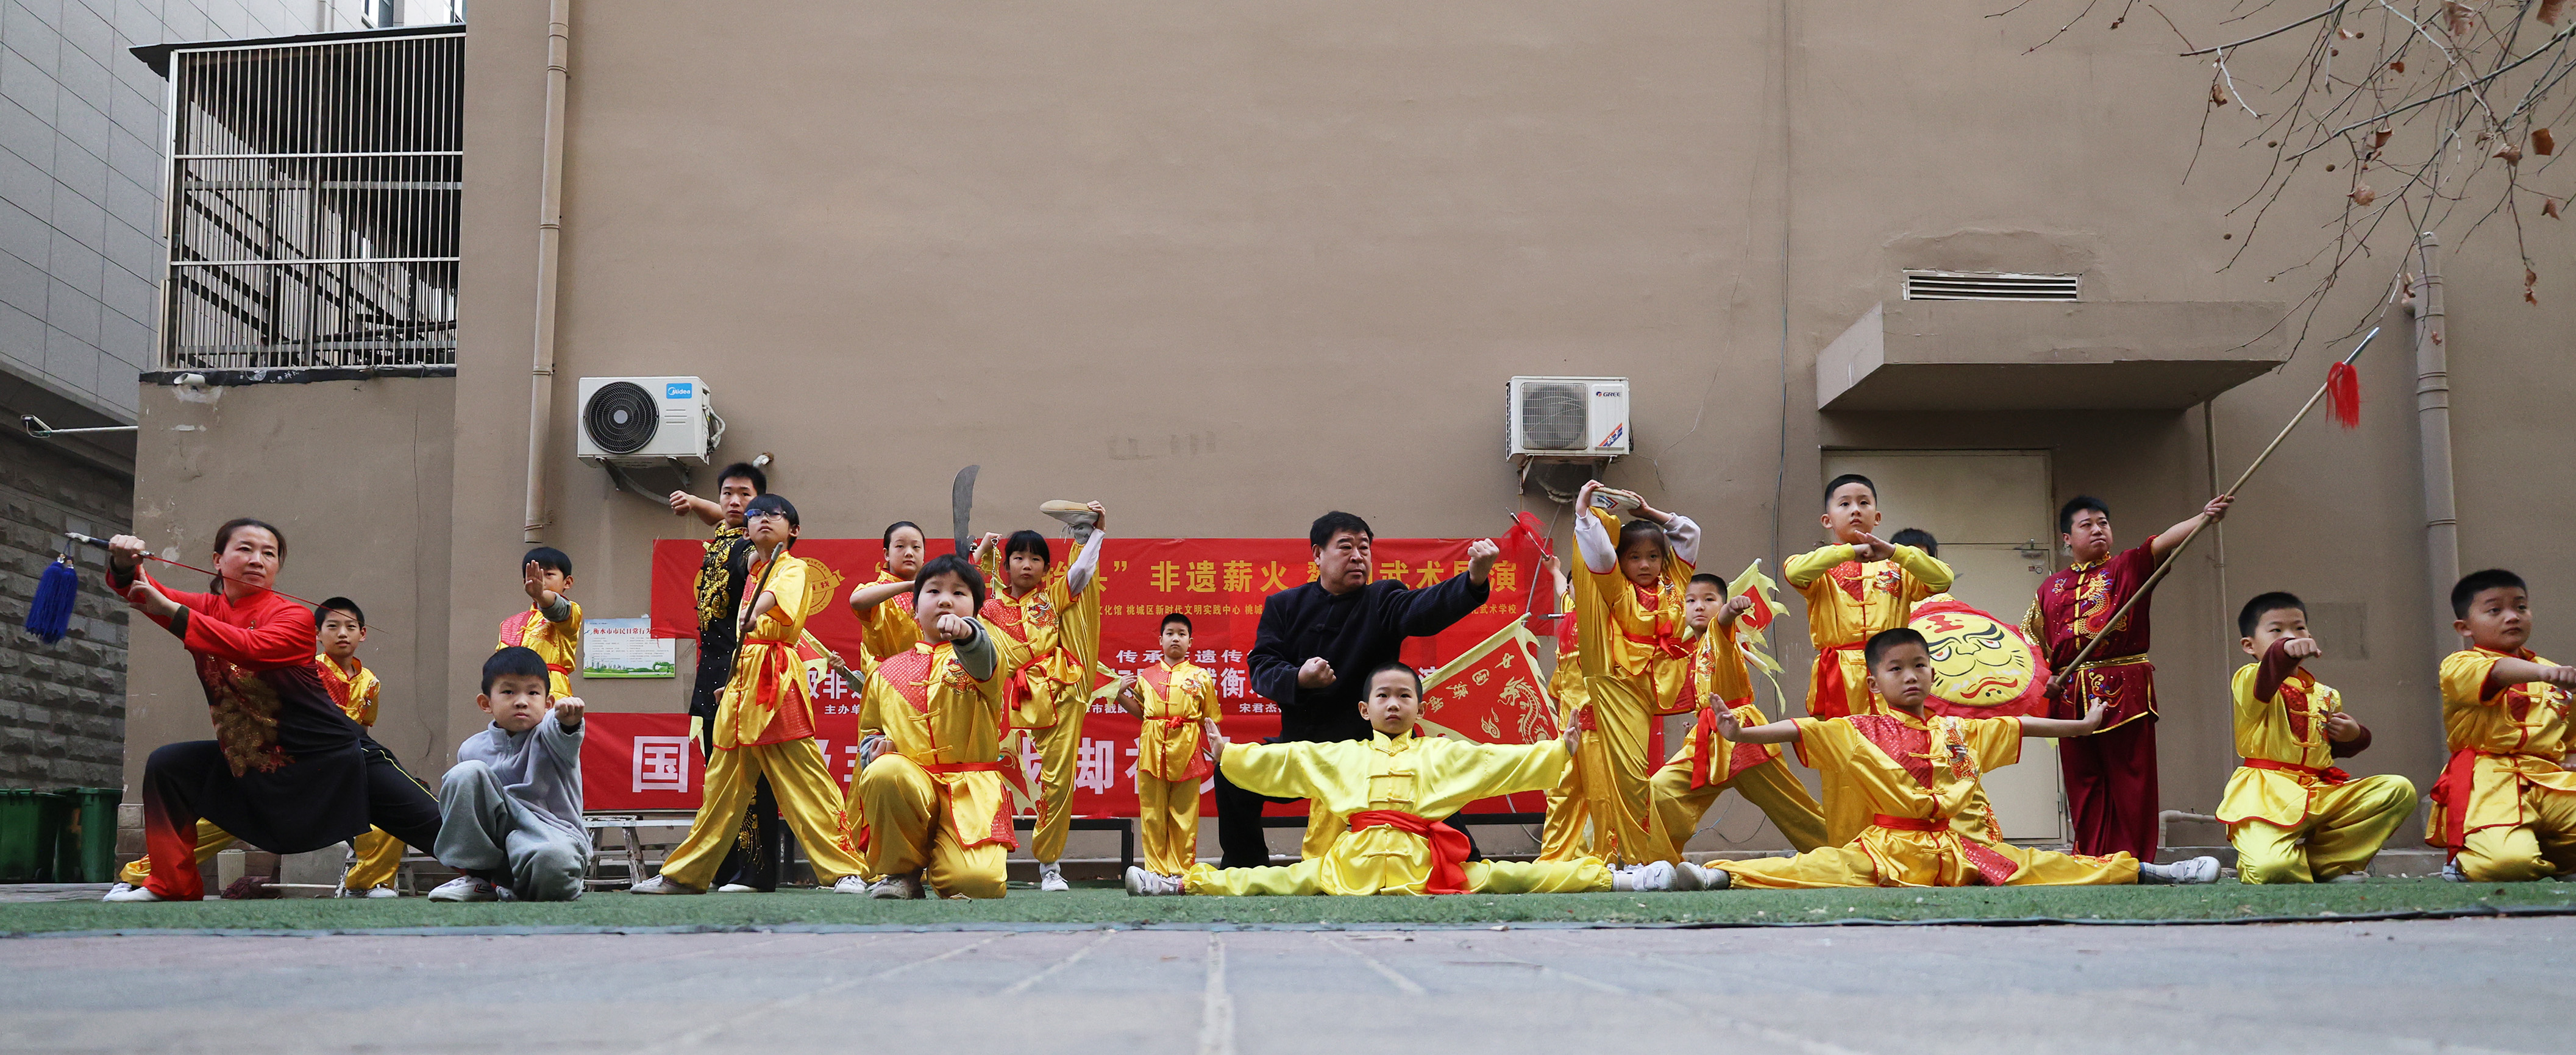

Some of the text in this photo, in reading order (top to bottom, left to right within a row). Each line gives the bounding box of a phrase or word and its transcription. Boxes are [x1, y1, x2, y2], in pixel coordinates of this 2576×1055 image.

[668, 387, 691, 396] Midea
[1150, 560, 1289, 593] 非遗薪火
[1307, 560, 1517, 592] 武术演
[1126, 604, 1240, 616] 桃城区新时代文明实践中心
[1116, 649, 1253, 664] 传承遗传
[1239, 703, 1282, 713] 宋君杰
